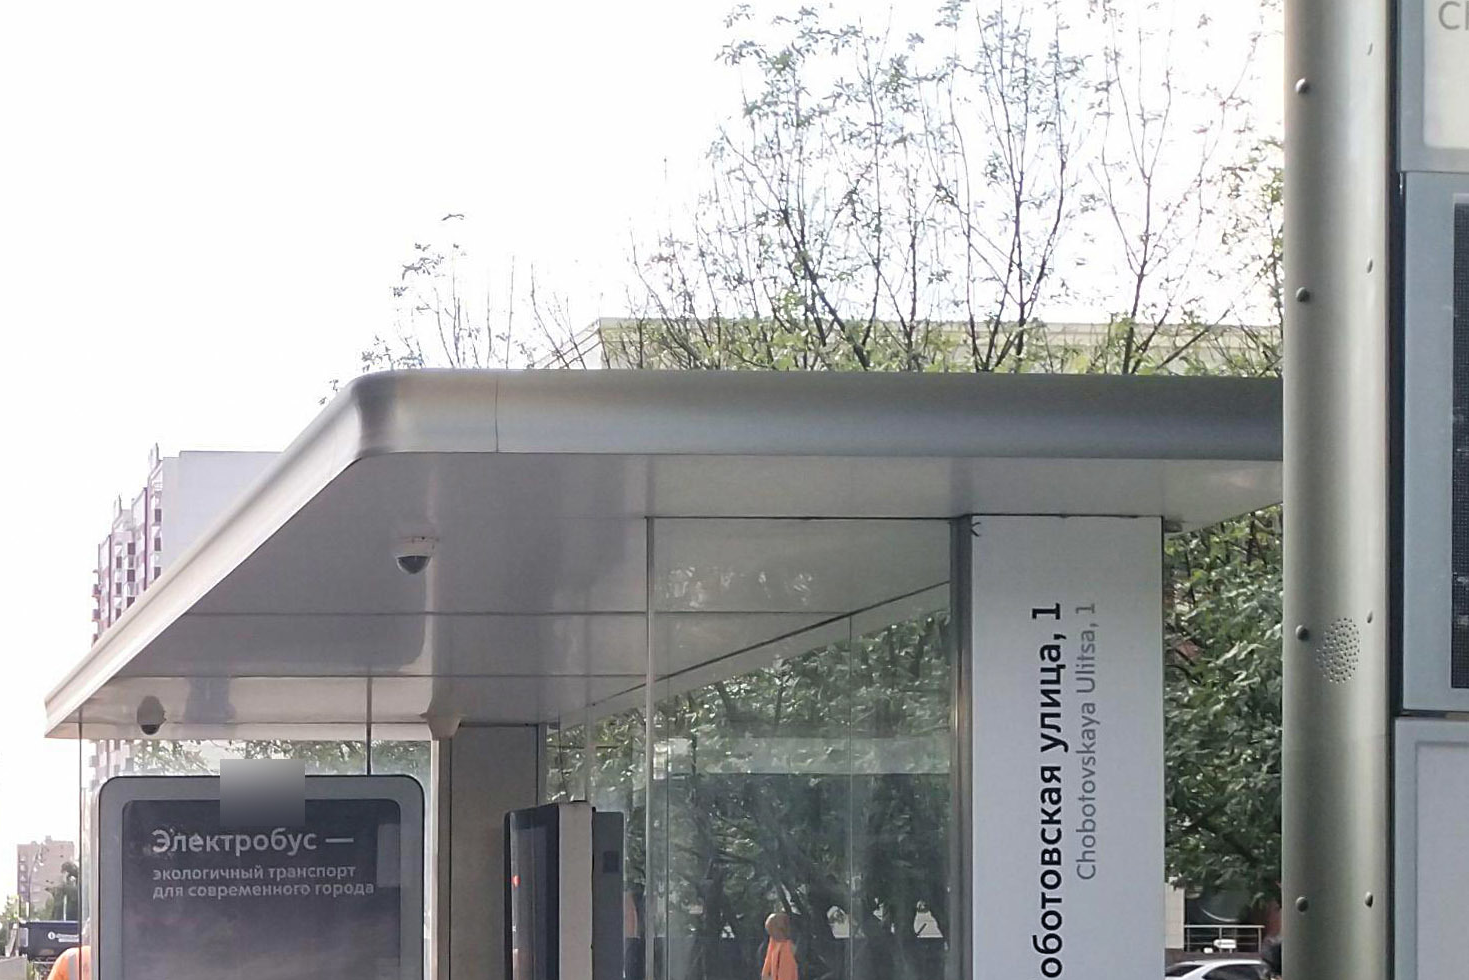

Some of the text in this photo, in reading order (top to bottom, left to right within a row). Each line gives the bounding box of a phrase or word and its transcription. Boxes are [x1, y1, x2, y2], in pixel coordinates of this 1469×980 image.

[1032, 602, 1061, 620] 1
[1039, 632, 1068, 753] улица,
[1076, 602, 1101, 880] Chobotovskaya Ulitsa, 1
[151, 827, 318, 857] Электробус
[152, 865, 356, 881] экологичный транспорт
[152, 882, 375, 900] для современного города
